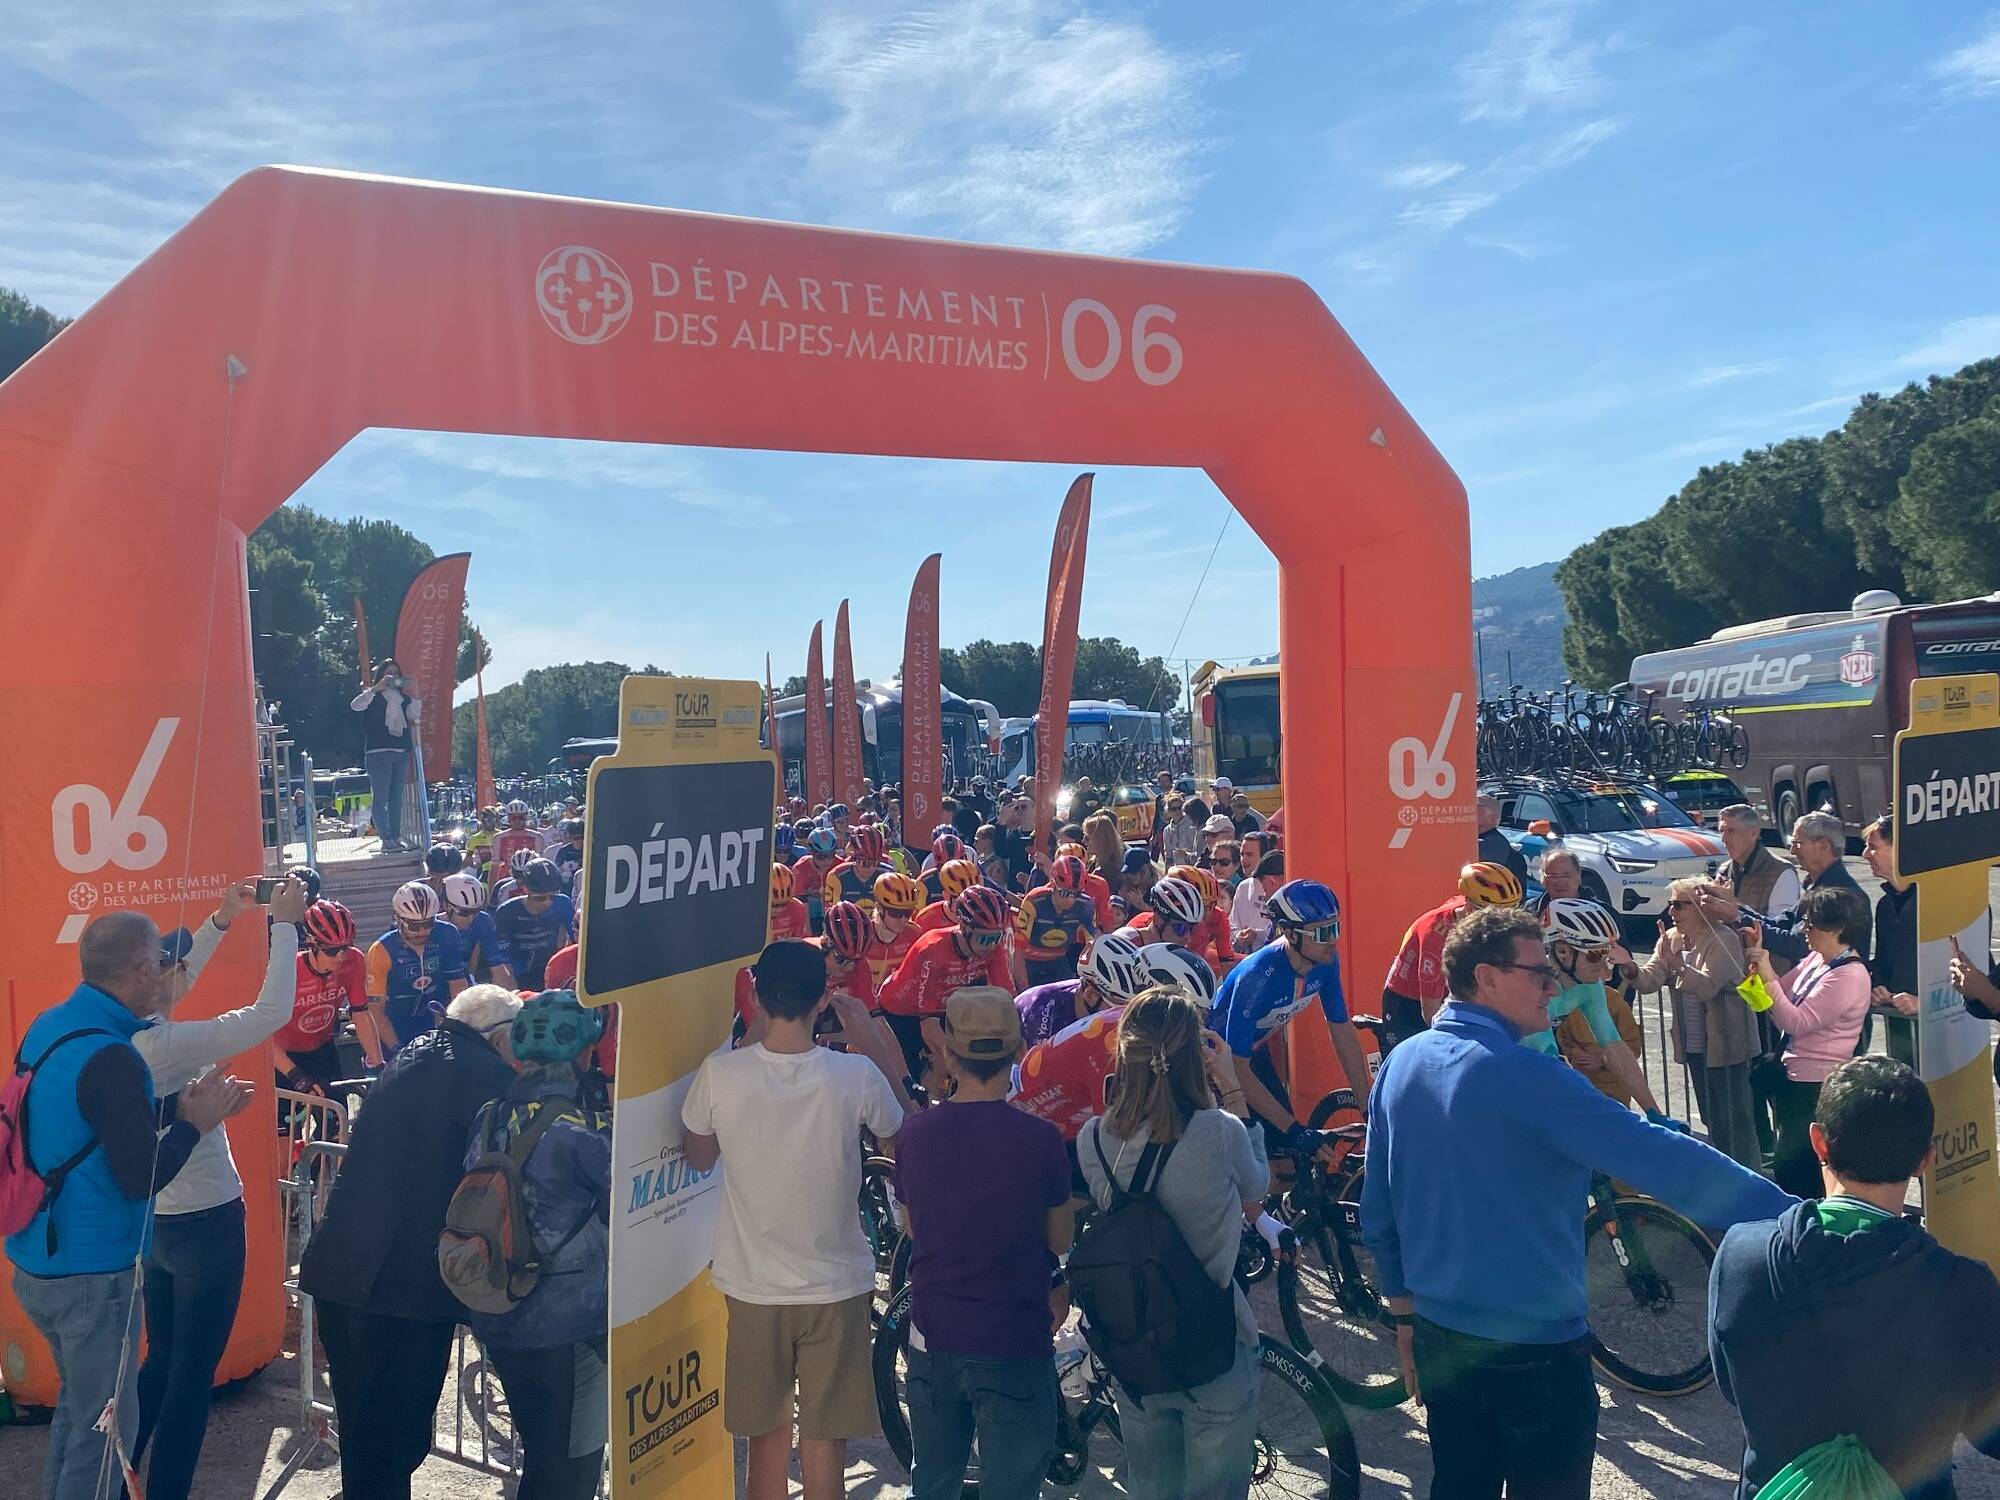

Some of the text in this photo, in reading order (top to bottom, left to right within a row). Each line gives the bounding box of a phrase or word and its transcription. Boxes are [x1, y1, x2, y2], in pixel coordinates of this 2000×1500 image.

[649, 258, 1025, 330] DÉPARTEMENT
[653, 311, 1029, 372] DES ALPES-MARITIMES
[1061, 297, 1184, 387] 06
[1666, 653, 1812, 703] corratec
[1840, 654, 1875, 681] NERI
[675, 694, 709, 717] TOUR
[1388, 692, 1463, 801] 06
[52, 717, 181, 875] 06
[1906, 769, 2000, 826] DÉPART
[103, 873, 228, 895] DÉPARTEMENT
[604, 822, 765, 911] DÉPART
[103, 895, 128, 908] DES
[625, 1350, 702, 1437] TOUR
[1265, 1350, 1314, 1393] SWISS SIDE
[630, 1442, 648, 1460] DES
[648, 1393, 717, 1450] ALPES-MARITIMES
